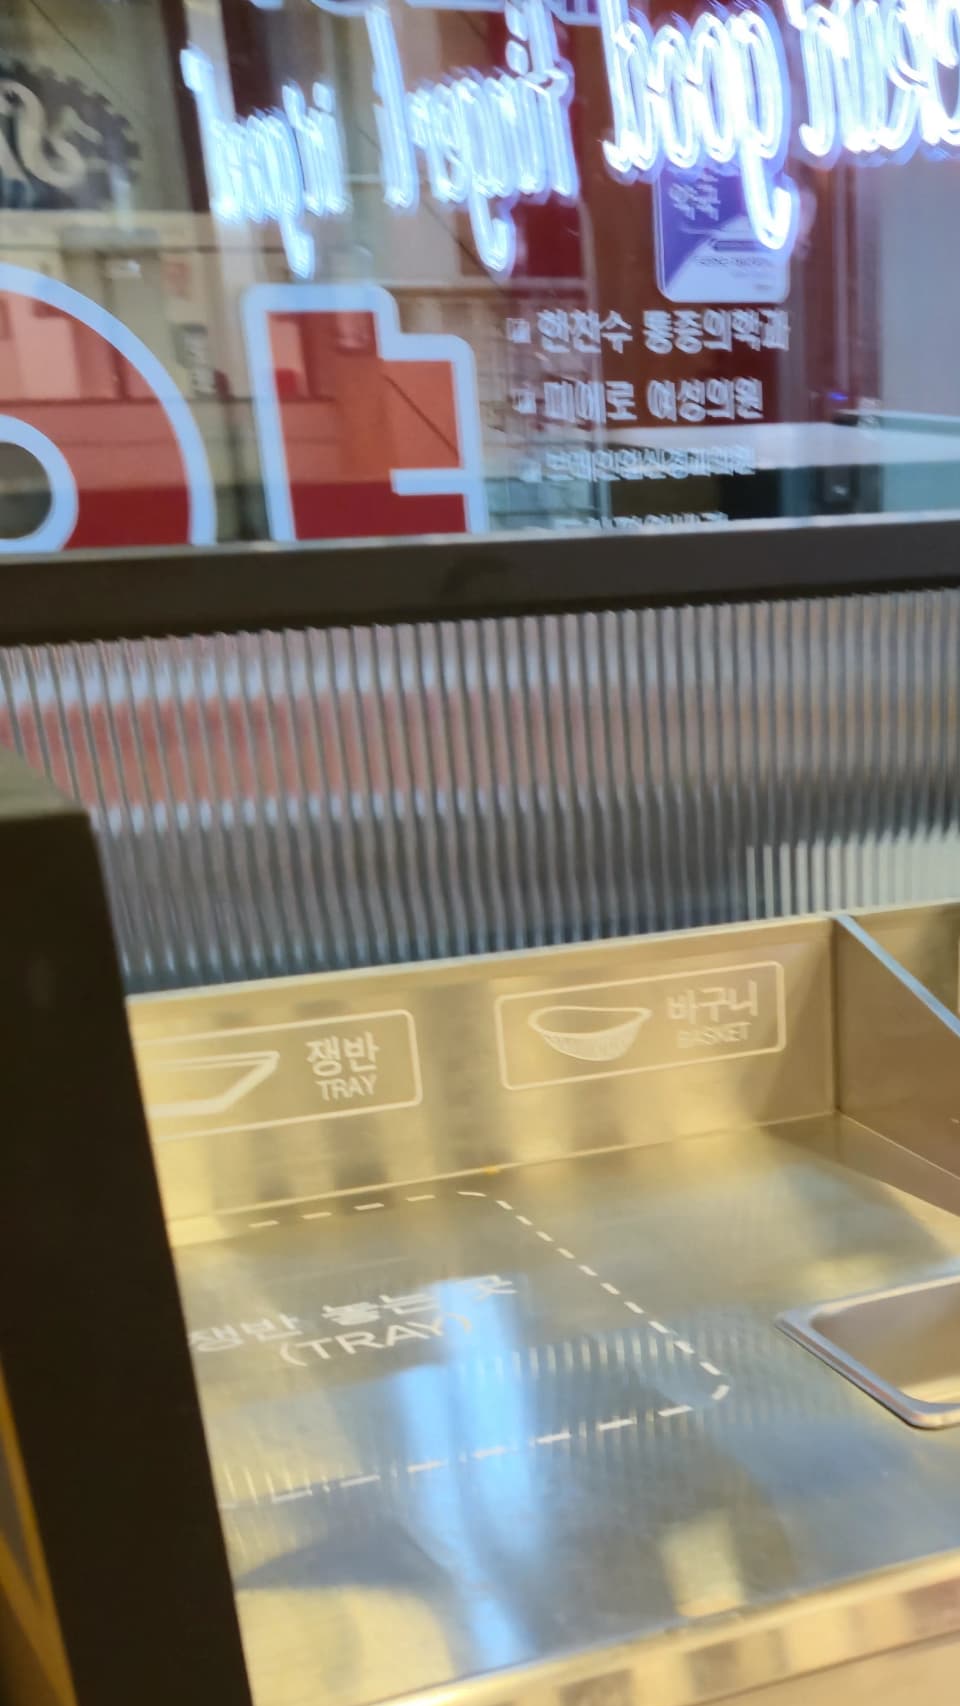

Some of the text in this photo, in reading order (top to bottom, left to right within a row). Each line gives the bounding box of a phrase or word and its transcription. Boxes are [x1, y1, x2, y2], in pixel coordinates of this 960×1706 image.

[646, 376, 765, 423] 여성의원
[666, 979, 759, 1025] 바구니
[304, 1031, 380, 1077] 쟁반
[676, 1021, 752, 1049] BASKET
[314, 1073, 377, 1102] TRAY
